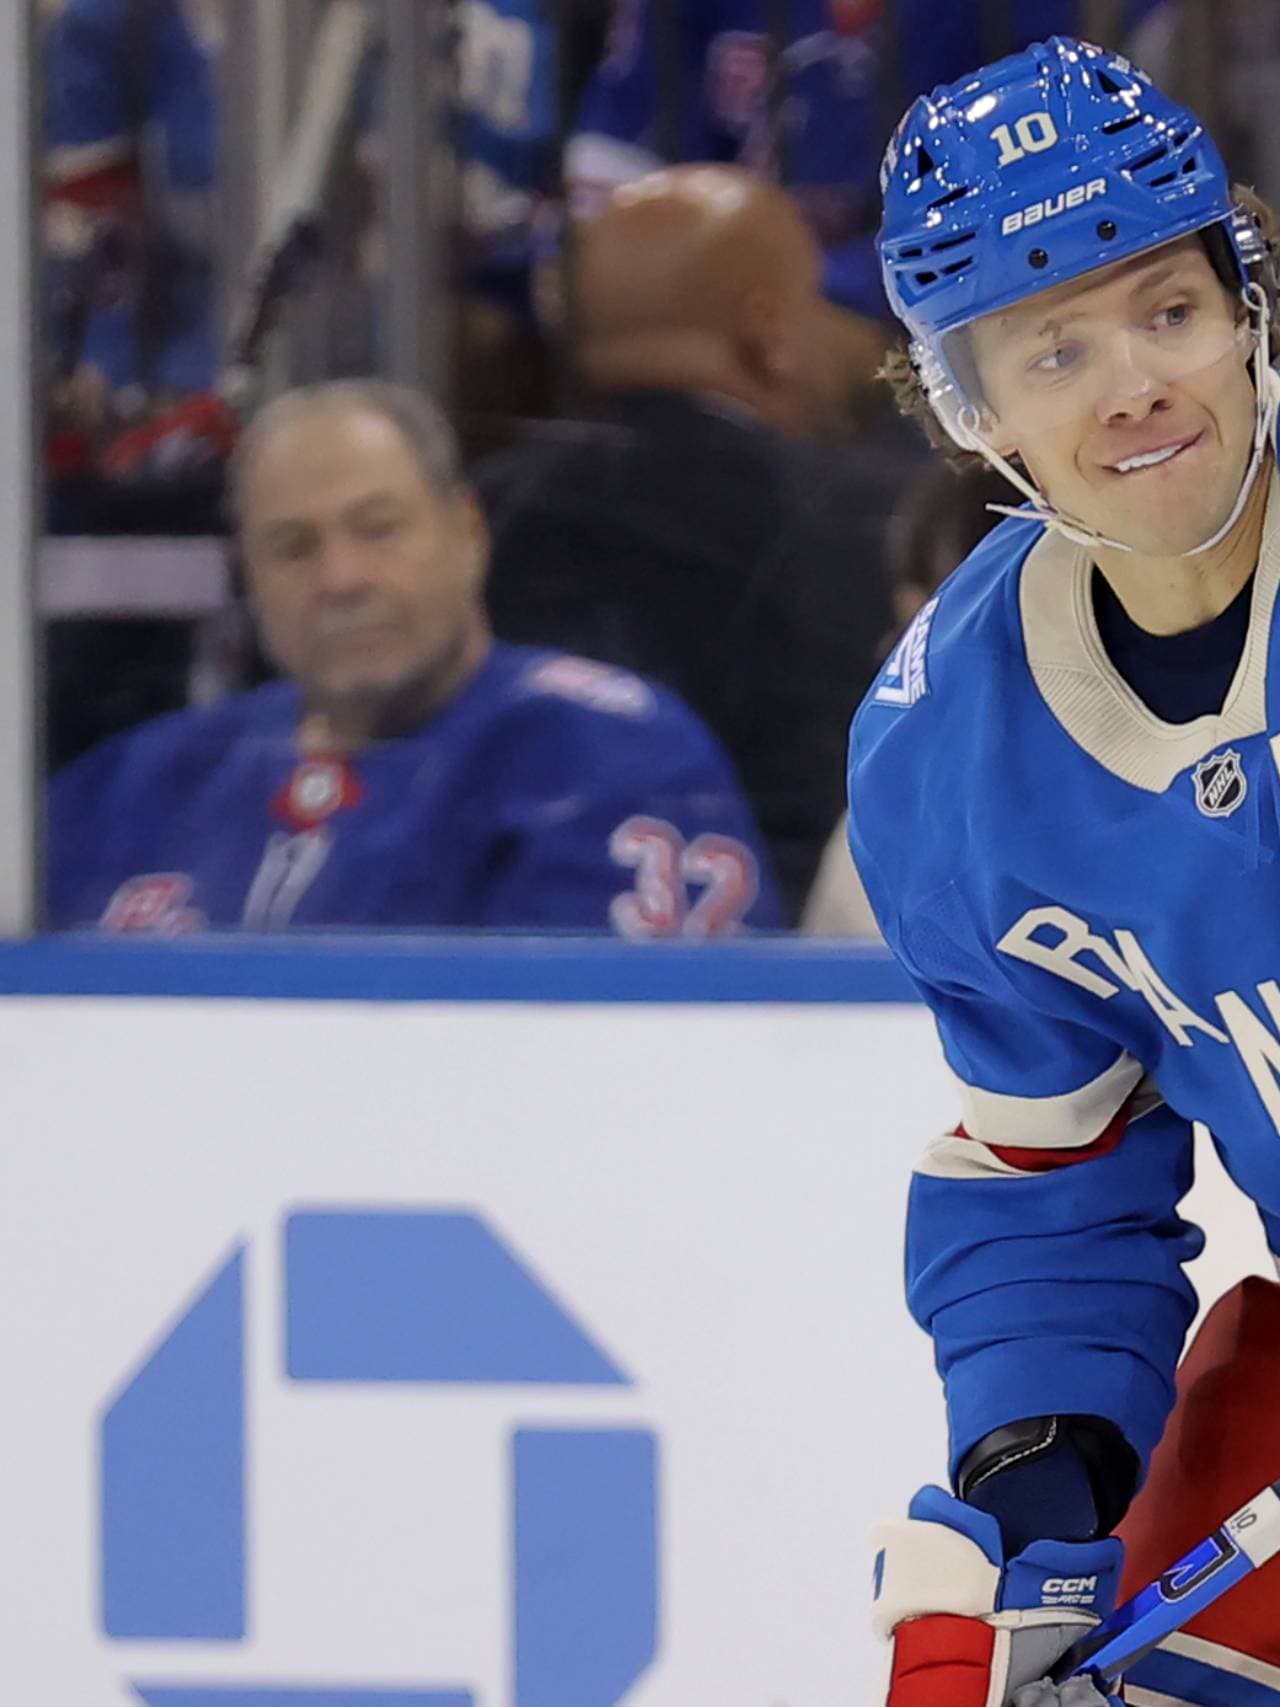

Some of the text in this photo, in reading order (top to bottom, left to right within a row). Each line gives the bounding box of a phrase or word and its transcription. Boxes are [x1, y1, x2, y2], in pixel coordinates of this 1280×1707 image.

[989, 111, 1059, 167] 10
[1002, 177, 1107, 236] BAUER
[1042, 1575, 1098, 1593] CCM
